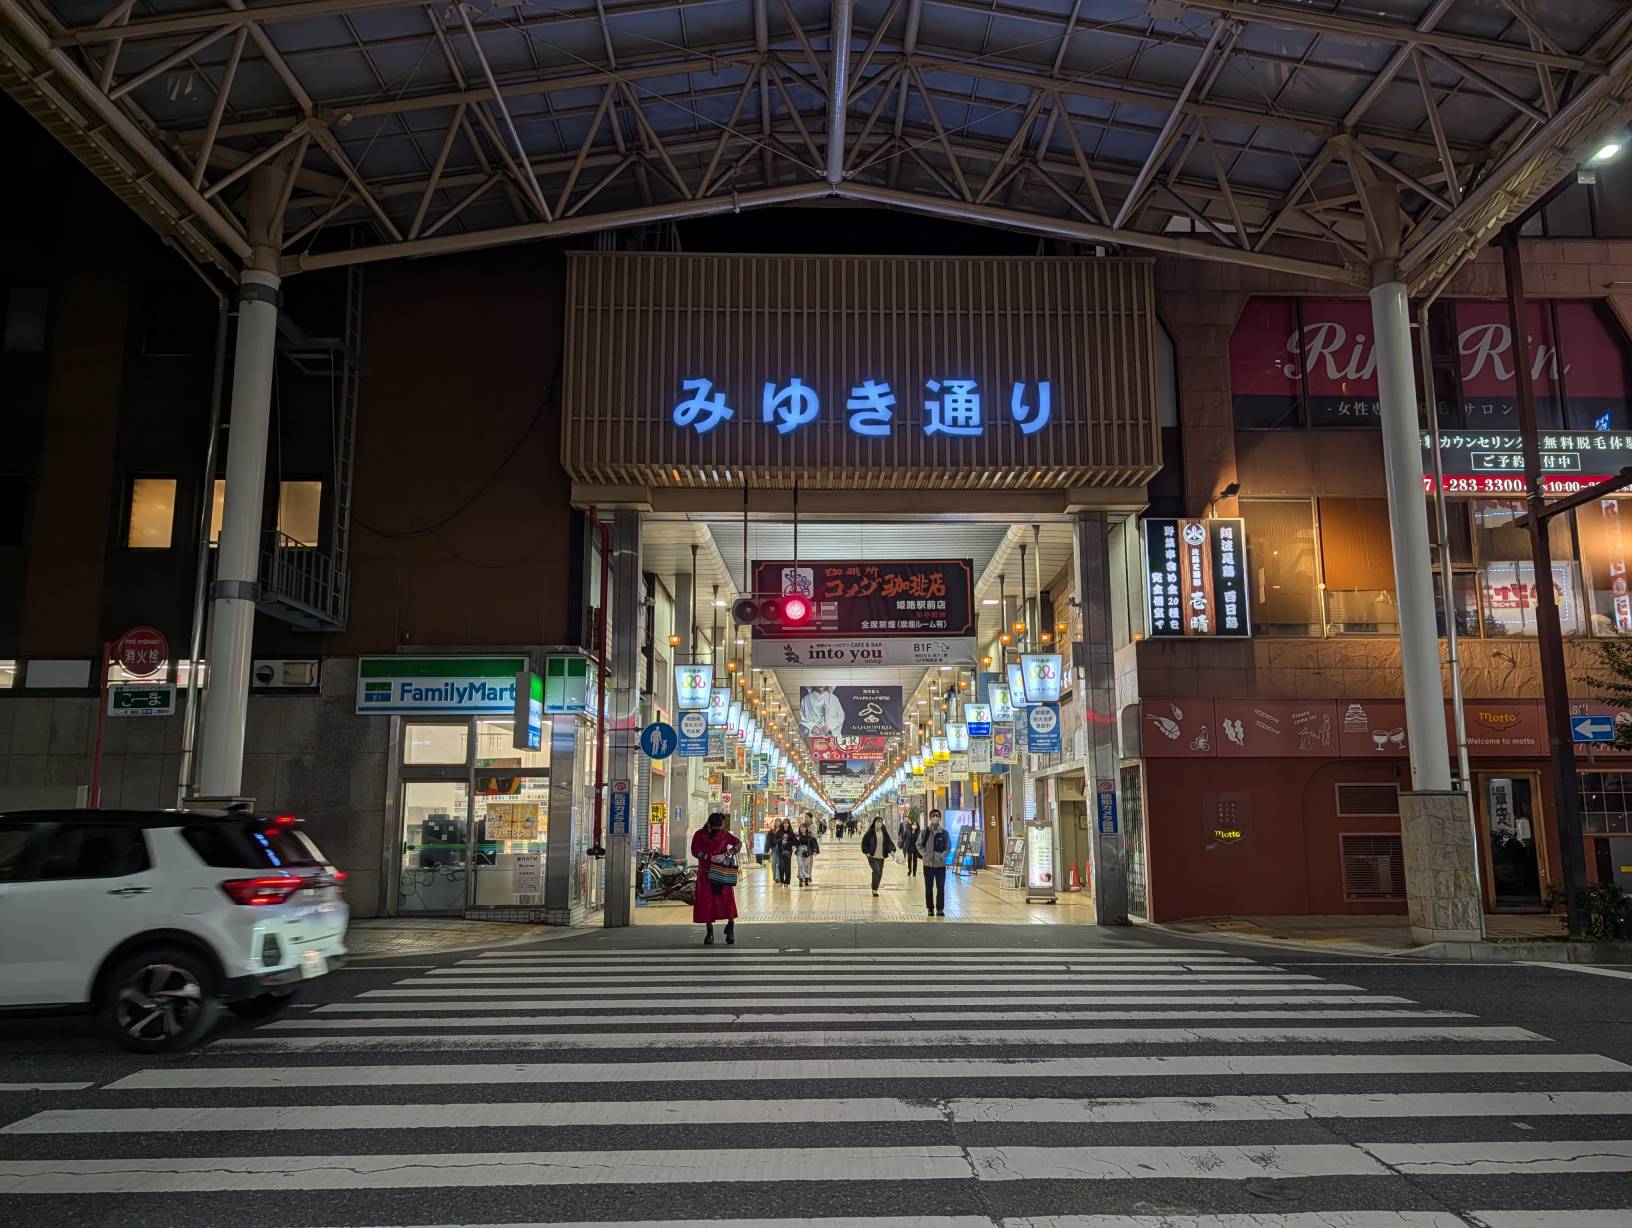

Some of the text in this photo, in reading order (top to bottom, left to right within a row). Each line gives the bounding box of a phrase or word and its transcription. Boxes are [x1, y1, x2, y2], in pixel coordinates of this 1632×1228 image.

[1460, 322, 1572, 381] Rn
[672, 377, 1052, 437] みゆき通り
[1464, 402, 1514, 415] サロン
[1483, 455, 1571, 468] ご予約付中
[1423, 478, 1522, 492] 7-283-3300
[824, 573, 946, 598] コメダ珈琲店
[896, 600, 947, 610] 姫路駅前店
[808, 645, 883, 663] into you
[914, 643, 932, 652] B1F
[125, 649, 159, 663] 消火栓
[400, 682, 517, 704] FamilyMart
[1466, 737, 1501, 745] Welcome
[651, 805, 659, 823] 時計
